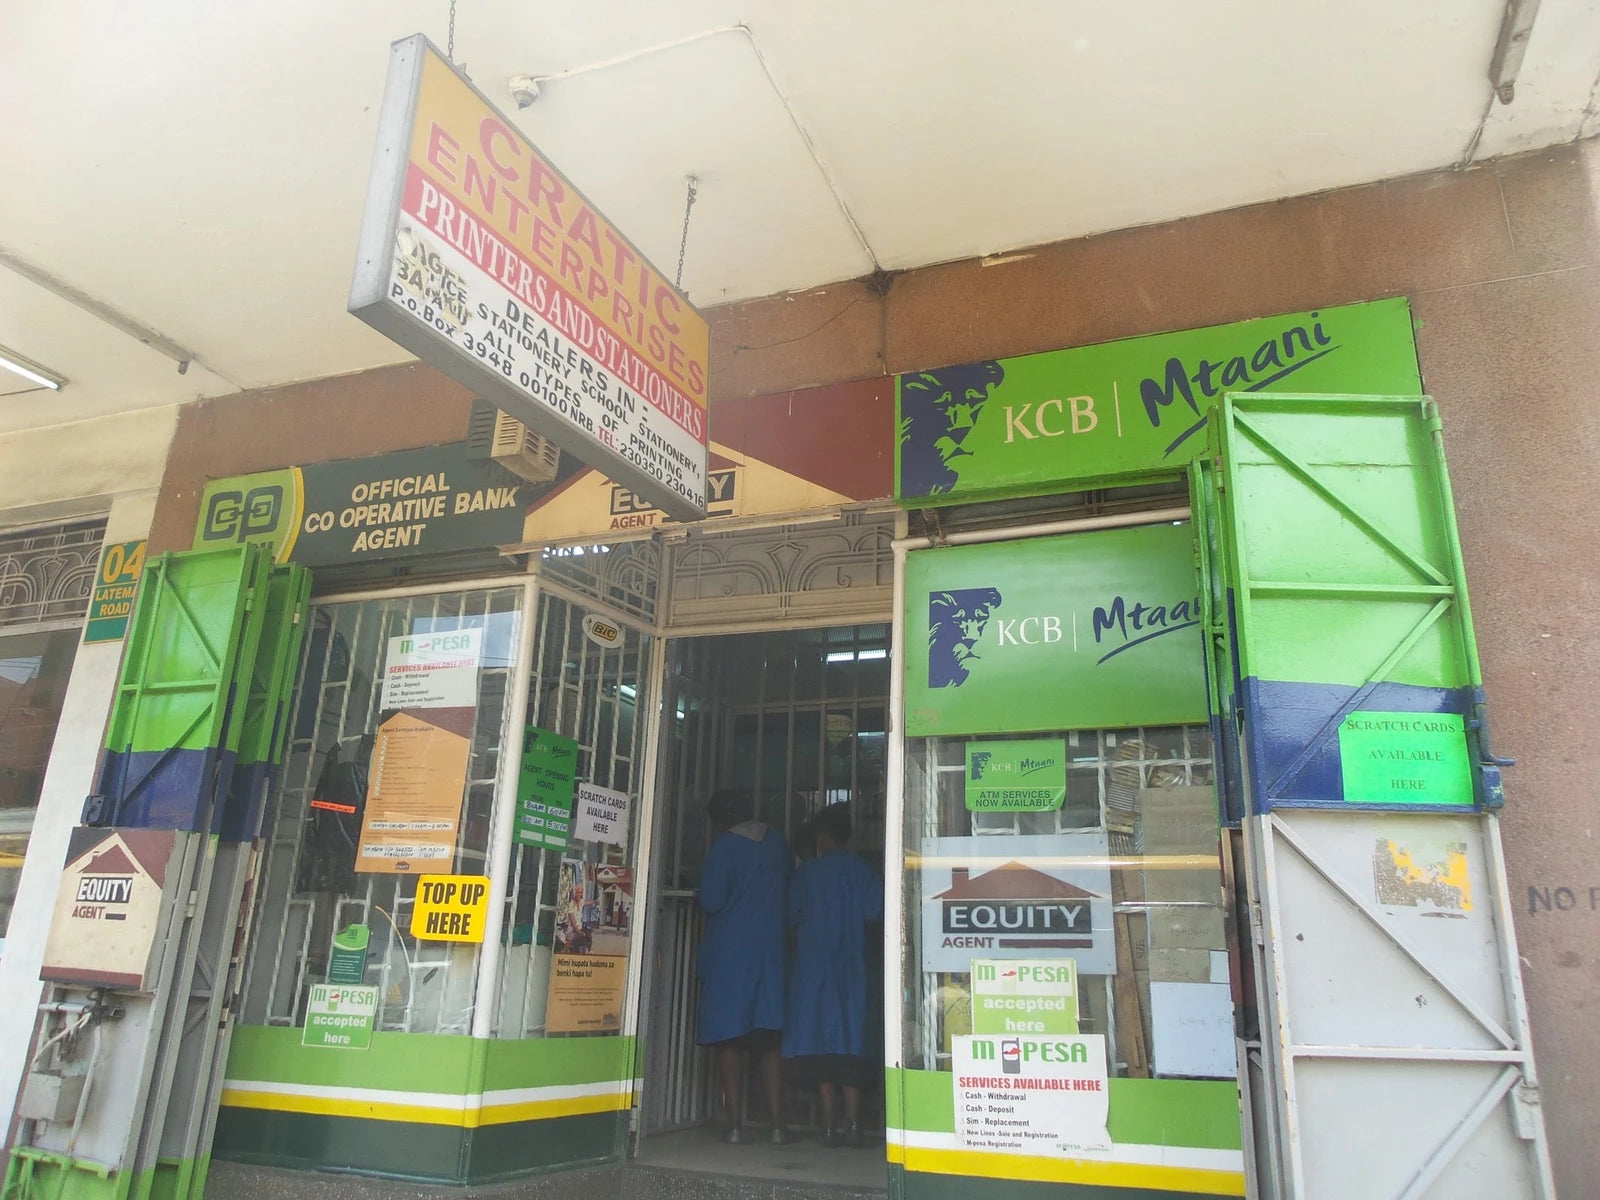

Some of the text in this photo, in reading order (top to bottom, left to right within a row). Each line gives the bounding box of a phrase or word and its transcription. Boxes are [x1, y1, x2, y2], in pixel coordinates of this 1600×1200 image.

[479, 114, 681, 336] CRATIC
[427, 121, 704, 396] ENTERPRISES
[417, 179, 548, 313] PRINTERS
[549, 290, 594, 350] AND
[594, 326, 702, 440] STATIONERS
[506, 299, 609, 392] DEALERS
[477, 302, 572, 379] STATIONERY
[581, 379, 629, 425] SCHOOL
[1002, 312, 1331, 444] KCB Mtaani
[483, 330, 683, 480] ALL TYPES OF PRINTING
[463, 332, 513, 377] 3948
[519, 372, 568, 414] 00100
[620, 442, 663, 481] 230350
[666, 473, 704, 508] 230416
[351, 472, 450, 503] OFFICIAL
[304, 486, 520, 533] CO OPERATIVE BANK
[610, 512, 657, 530] AGENT
[351, 523, 426, 553] AGENT
[103, 541, 146, 583] 04
[100, 602, 130, 616] ROAD
[996, 616, 1063, 646] KCB
[389, 663, 421, 674] SERVICES
[1346, 719, 1456, 733] SCRATCH CARDS
[1368, 750, 1443, 762] AVAILABLE
[1391, 779, 1426, 790] HERE
[580, 790, 627, 810] SCRATCH CARDS
[1002, 790, 1051, 798] SERVICES
[586, 806, 618, 822] AVAILABLE
[593, 821, 609, 834] HERE
[77, 878, 132, 901] EQUITY
[423, 882, 485, 906] TOP UP
[1528, 885, 1577, 912] NO
[72, 906, 106, 919] AGENT
[950, 905, 1082, 929] EQUITY
[426, 912, 472, 935] HERE
[941, 937, 995, 949] AGENT
[557, 958, 571, 967] Mimi
[571, 959, 589, 969] hupata
[572, 970, 585, 979] hapa
[983, 997, 1066, 1012] accepted
[313, 1015, 367, 1028] accepted
[1005, 1018, 1046, 1032] here
[324, 1032, 351, 1044] here
[959, 1077, 1102, 1091] SERVICES AVAILABLE HERE
[965, 1092, 982, 1100] Cash
[988, 1092, 1027, 1101] Withdrawal
[965, 1104, 983, 1113] Cash
[988, 1105, 1015, 1114] Deposit
[966, 1117, 979, 1125] Sim
[985, 1118, 1030, 1127] Replacement
[988, 1140, 1022, 1148] Registration
